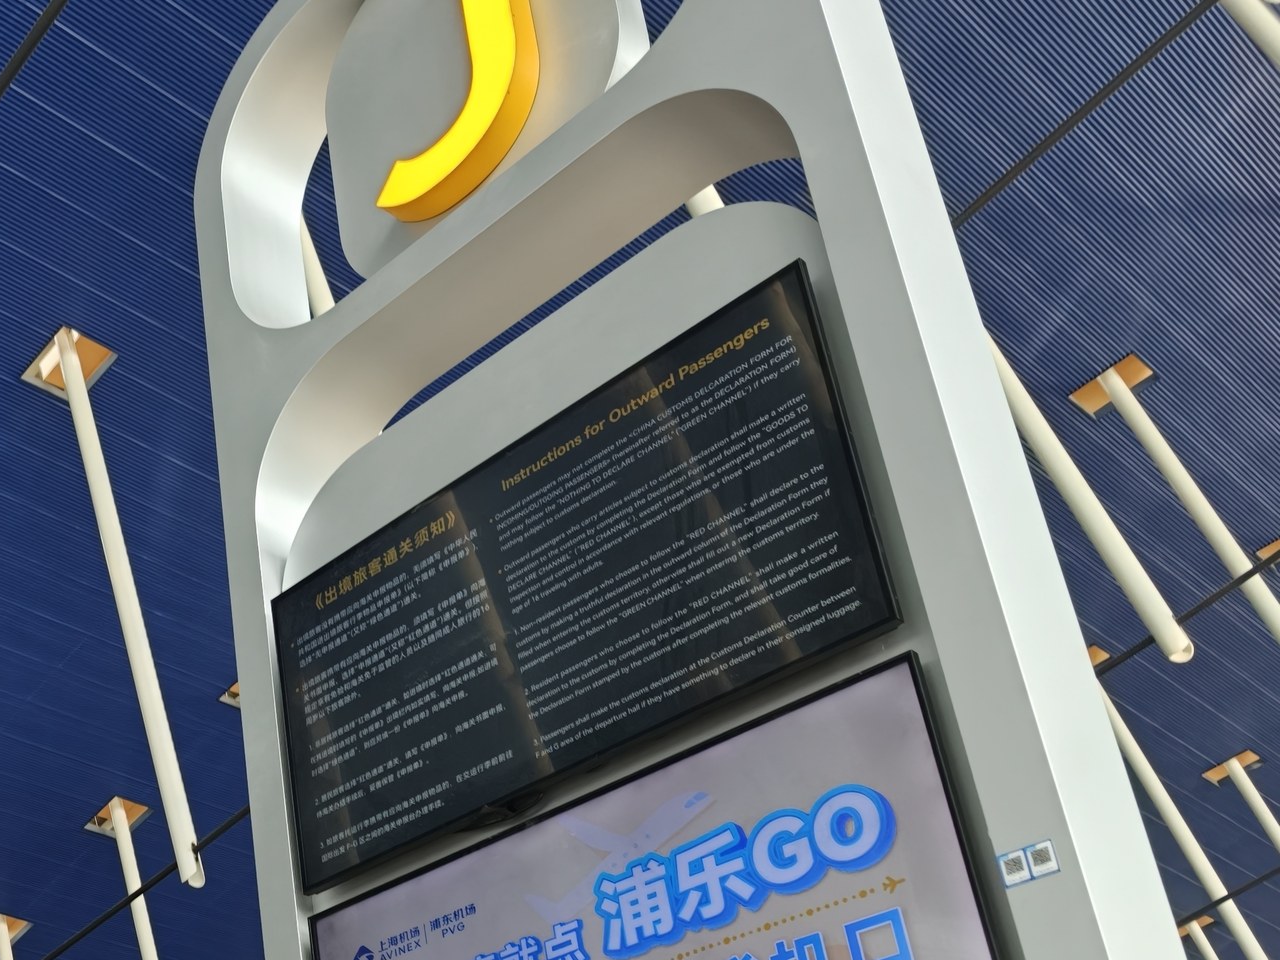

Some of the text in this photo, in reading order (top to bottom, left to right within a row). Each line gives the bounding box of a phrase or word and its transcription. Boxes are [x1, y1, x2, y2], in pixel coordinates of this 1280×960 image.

[494, 500, 521, 521] Outward
[521, 480, 557, 506] passengers
[557, 471, 571, 483] may
[571, 463, 584, 474] not
[584, 444, 615, 466] complete
[615, 436, 628, 447] the
[656, 395, 694, 422] CUSTOMS
[749, 346, 774, 365] FORM
[774, 334, 793, 350] FOR
[498, 529, 511, 542] and
[511, 523, 524, 534] may
[524, 510, 544, 526] follow
[544, 503, 556, 514] the
[591, 475, 602, 486] TO
[602, 455, 636, 479] DECLARE
[753, 380, 759, 389] if
[760, 371, 778, 385] they
[779, 357, 801, 373] carry
[501, 318, 770, 492] Instructions for Outward Passengers
[503, 551, 530, 572] Outward
[530, 532, 566, 558] passengers
[565, 523, 581, 536] who
[580, 513, 598, 527] carry
[598, 499, 623, 517] articles
[623, 483, 649, 502] subject
[649, 479, 658, 487] to
[658, 461, 688, 482] customs
[688, 437, 730, 465] declaration
[730, 425, 748, 441] shall
[748, 414, 770, 430] make
[777, 393, 806, 413] written
[652, 415, 680, 437] referred
[680, 411, 690, 420] to
[690, 405, 700, 414] as
[700, 397, 714, 408] the
[714, 362, 769, 400] DECLARATION
[314, 509, 457, 612] 《出境旅客通关须知》
[505, 559, 540, 583] declaration
[539, 555, 548, 563] to
[547, 548, 559, 558] the
[559, 532, 587, 552] customs
[586, 527, 595, 536] by
[596, 505, 634, 530] completing
[633, 498, 647, 509] the
[646, 474, 687, 501] Declaration
[687, 463, 707, 478] Form
[708, 452, 723, 466] and
[723, 440, 747, 457] follow
[747, 432, 761, 443] the
[795, 403, 809, 414] TO
[519, 606, 562, 633] Non-resident
[562, 586, 599, 611] passengers
[599, 577, 615, 589] who
[614, 564, 640, 581] choose
[640, 559, 649, 567] to
[649, 546, 671, 562] follow
[672, 539, 685, 550] the
[749, 492, 768, 508] shall
[769, 477, 799, 497] declare
[799, 472, 810, 481] to
[809, 463, 825, 475] the
[530, 673, 560, 693] Resident
[560, 653, 599, 679] passengers
[598, 645, 615, 657] who
[614, 632, 641, 649] choose
[641, 627, 650, 636] to
[650, 615, 674, 631] follow
[674, 607, 688, 618] the
[754, 562, 775, 578] shall
[775, 551, 798, 567] make
[807, 530, 839, 550] written
[378, 926, 420, 953] 上海机场
[429, 903, 477, 931] 浦东机场
[441, 921, 466, 939] PVG
[594, 784, 897, 960] 浦乐GO
